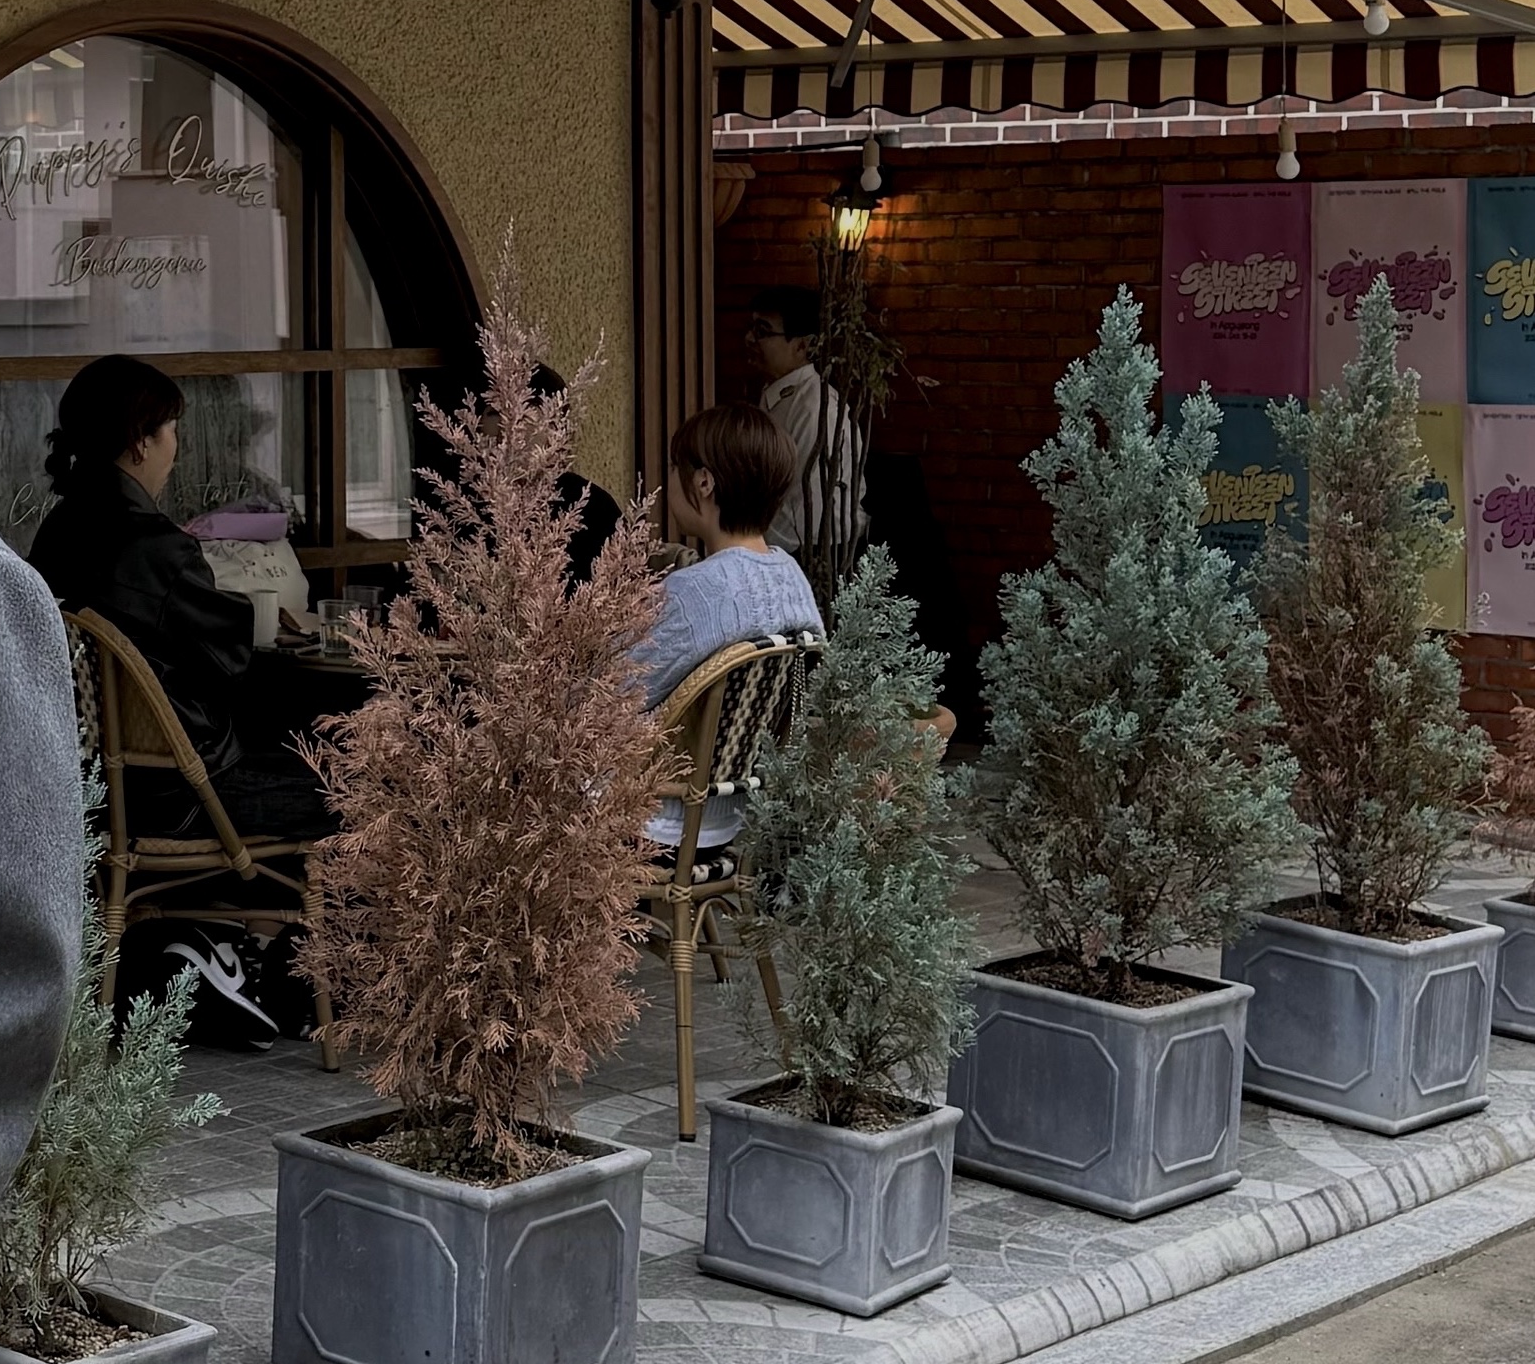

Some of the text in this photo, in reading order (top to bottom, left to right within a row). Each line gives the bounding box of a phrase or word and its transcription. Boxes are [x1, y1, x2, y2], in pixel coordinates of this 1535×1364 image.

[168, 115, 267, 208] Quishe
[1177, 253, 1298, 296] SEVENTEEN
[1193, 282, 1285, 319] STREET
[1200, 465, 1295, 497] EVENTEEN
